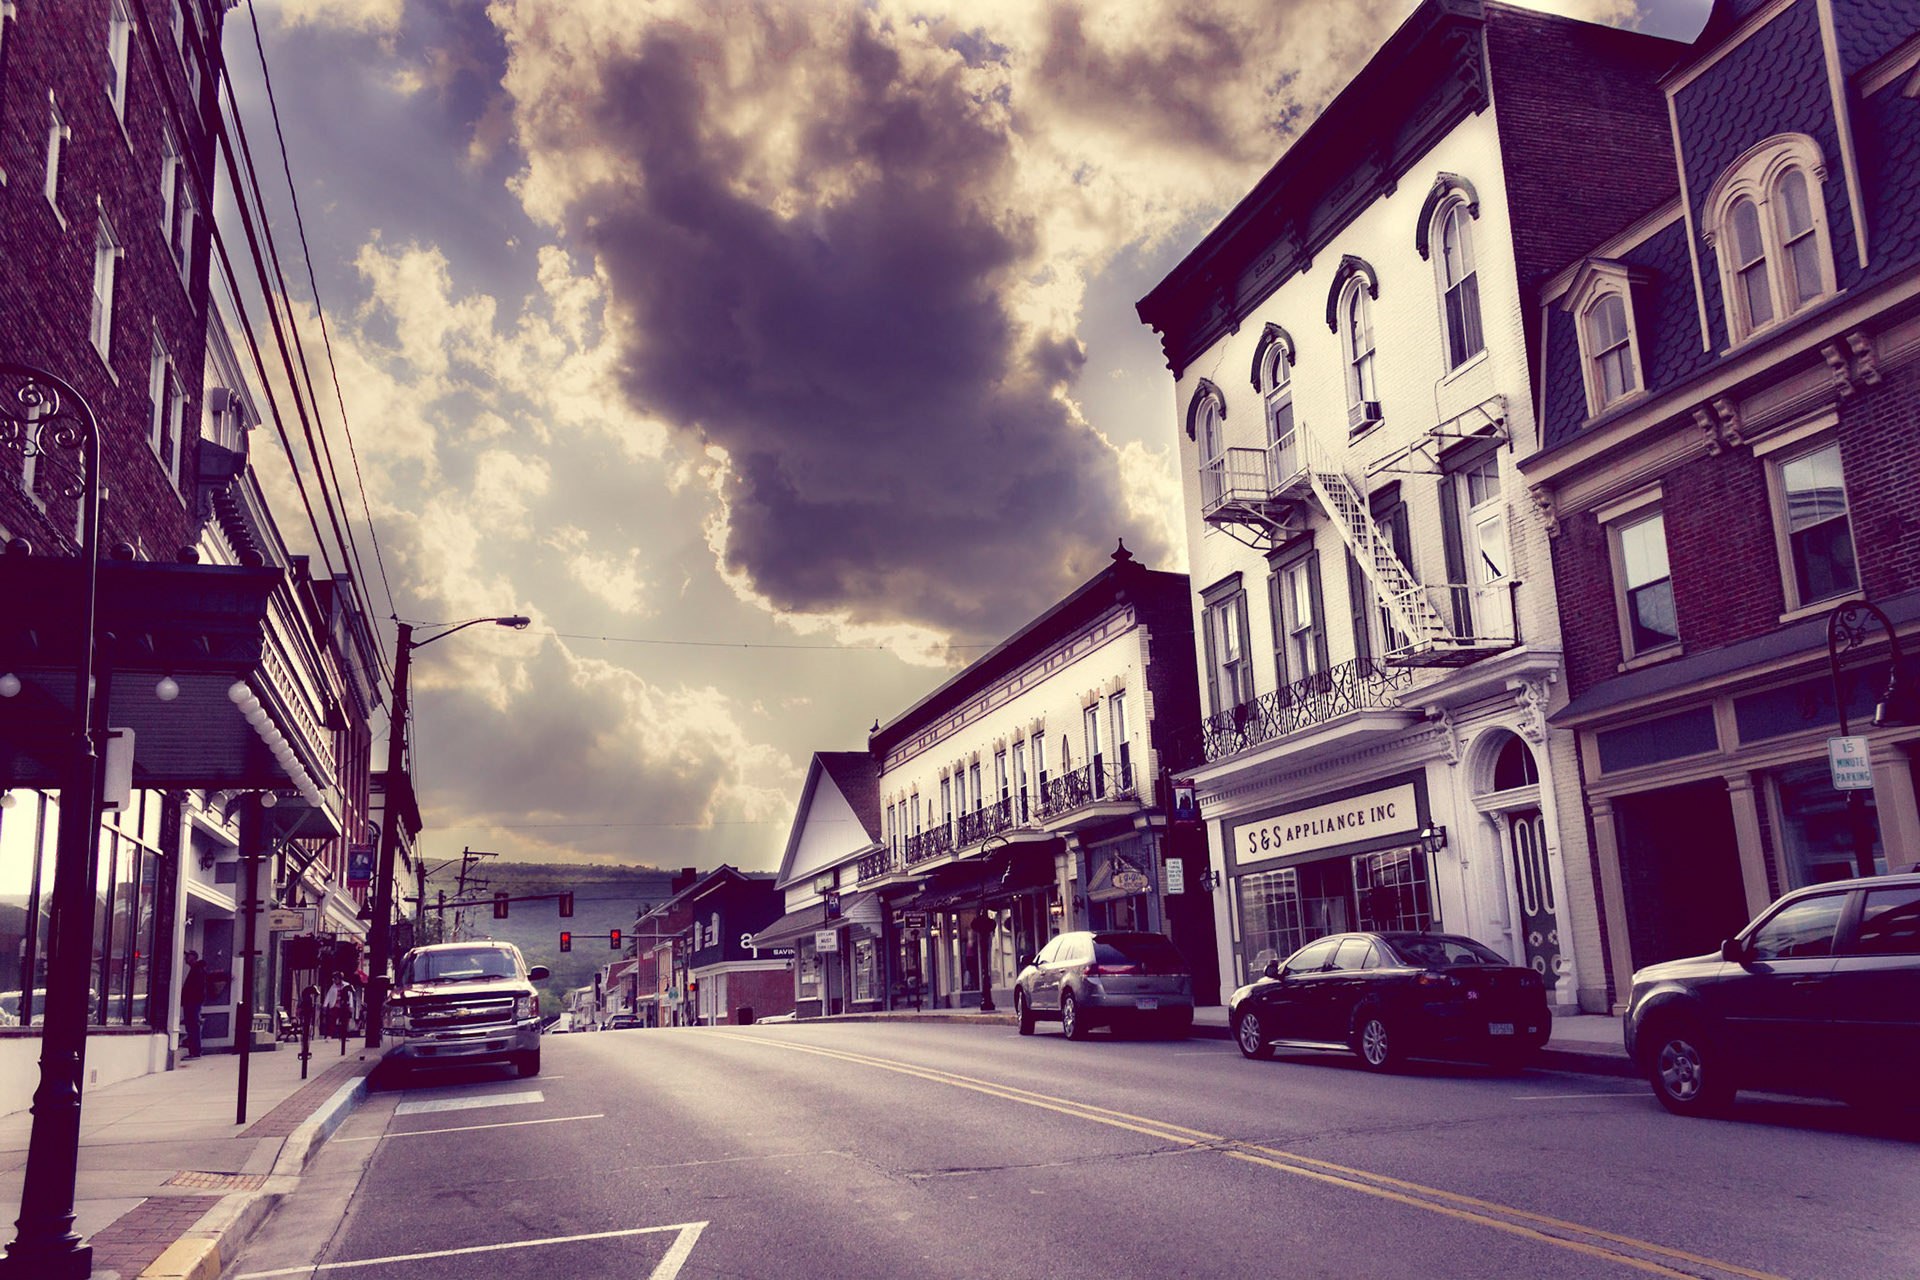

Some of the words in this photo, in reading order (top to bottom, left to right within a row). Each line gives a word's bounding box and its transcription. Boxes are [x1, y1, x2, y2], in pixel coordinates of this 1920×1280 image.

[1842, 743, 1854, 753] 15
[1836, 757, 1865, 768] MINUTE
[1836, 771, 1869, 782] PARKING
[1286, 811, 1364, 842] APPLIANCE
[1370, 802, 1396, 823] INC
[1468, 991, 1478, 999] 5k
